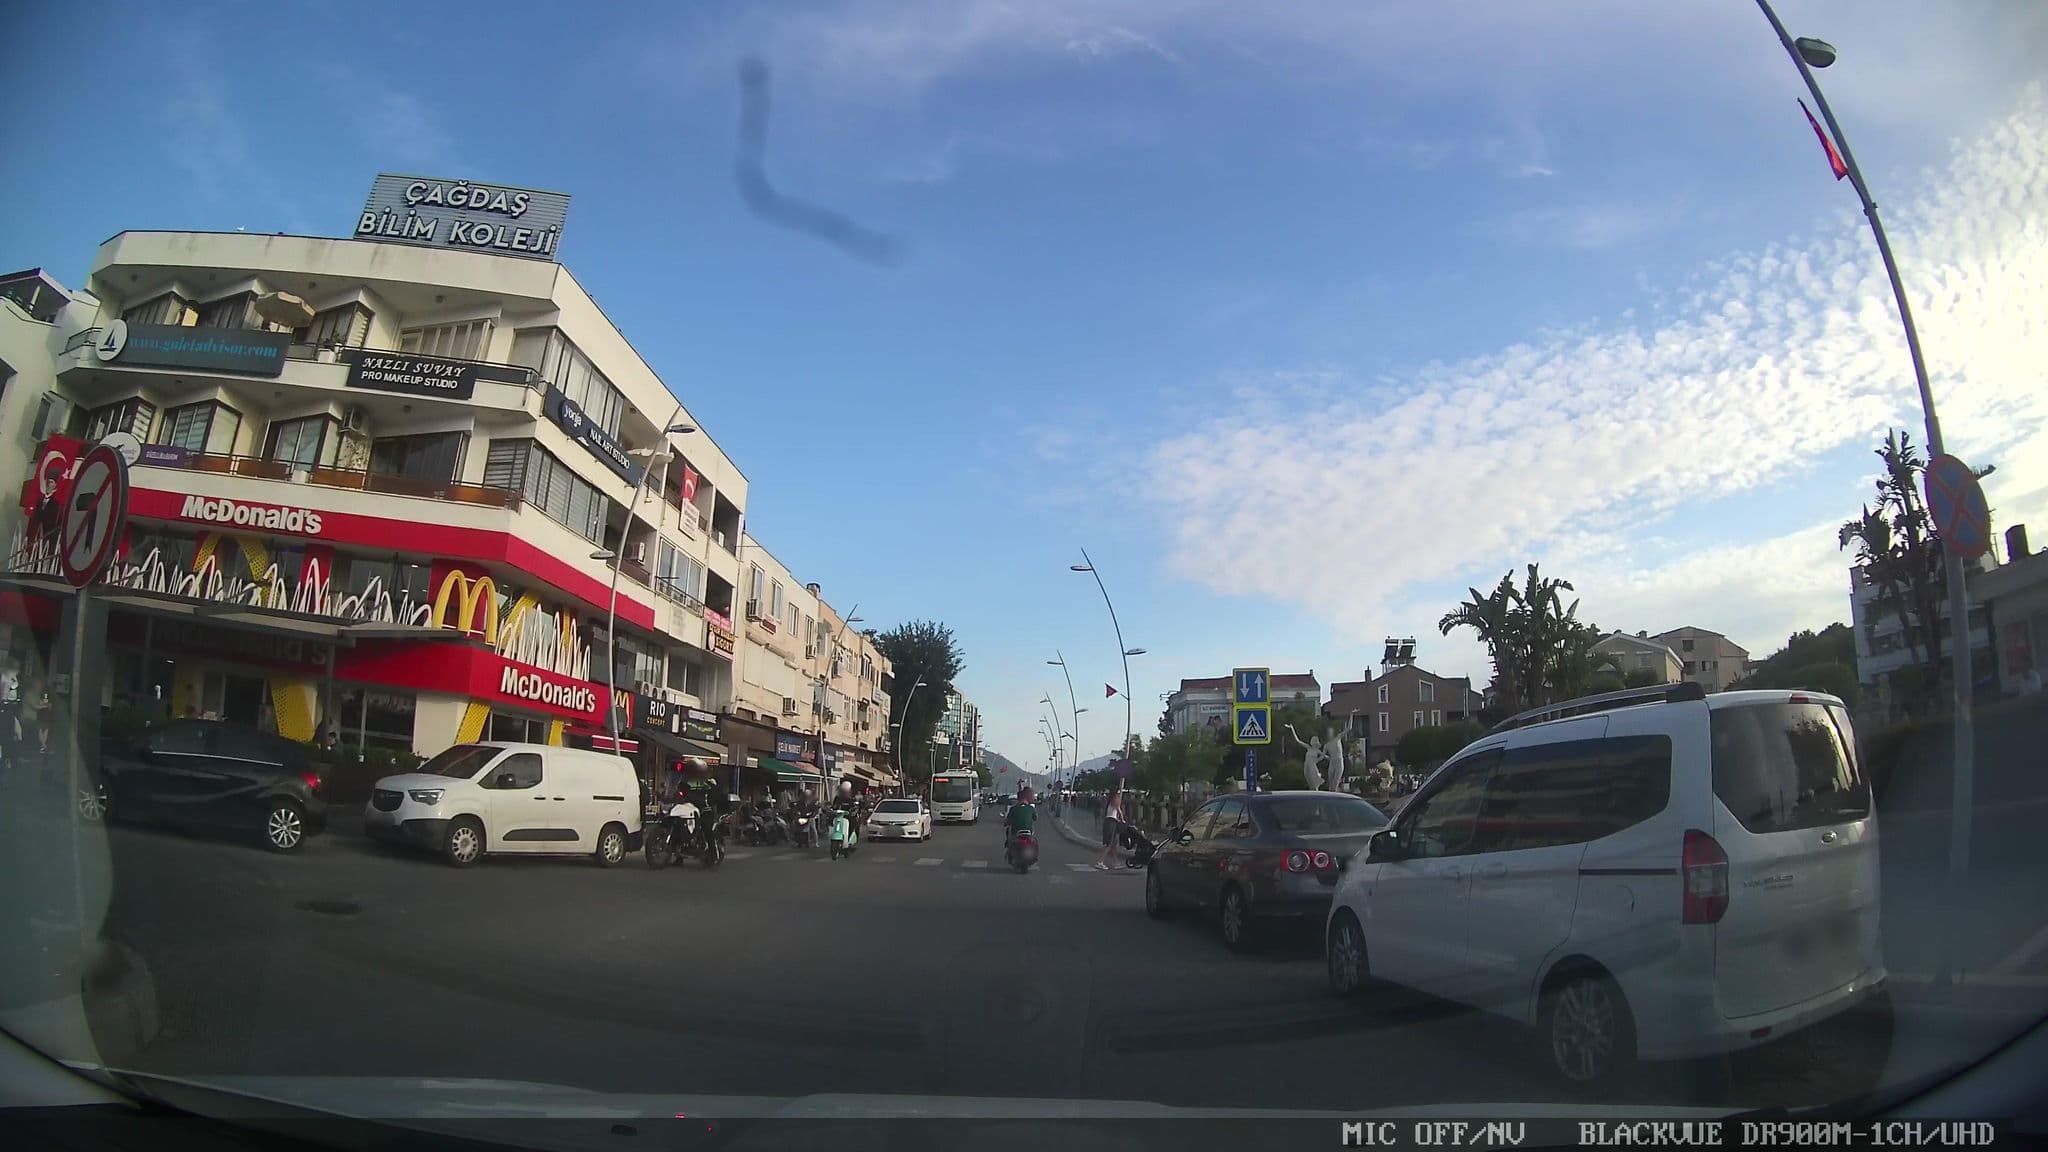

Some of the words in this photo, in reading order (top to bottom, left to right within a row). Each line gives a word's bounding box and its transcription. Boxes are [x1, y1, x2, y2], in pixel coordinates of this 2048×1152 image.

[405, 180, 530, 217] ÇAĞDAŞ
[357, 206, 438, 241] BİLİM
[448, 220, 559, 254] KOLEJİ
[361, 370, 382, 381] PRO
[423, 377, 458, 389] STUDIO
[362, 356, 410, 371] NAZLI
[412, 361, 466, 378] SUVAY
[181, 495, 322, 535] McDonald's
[500, 666, 596, 713] McDonald's
[649, 700, 666, 717] RIO
